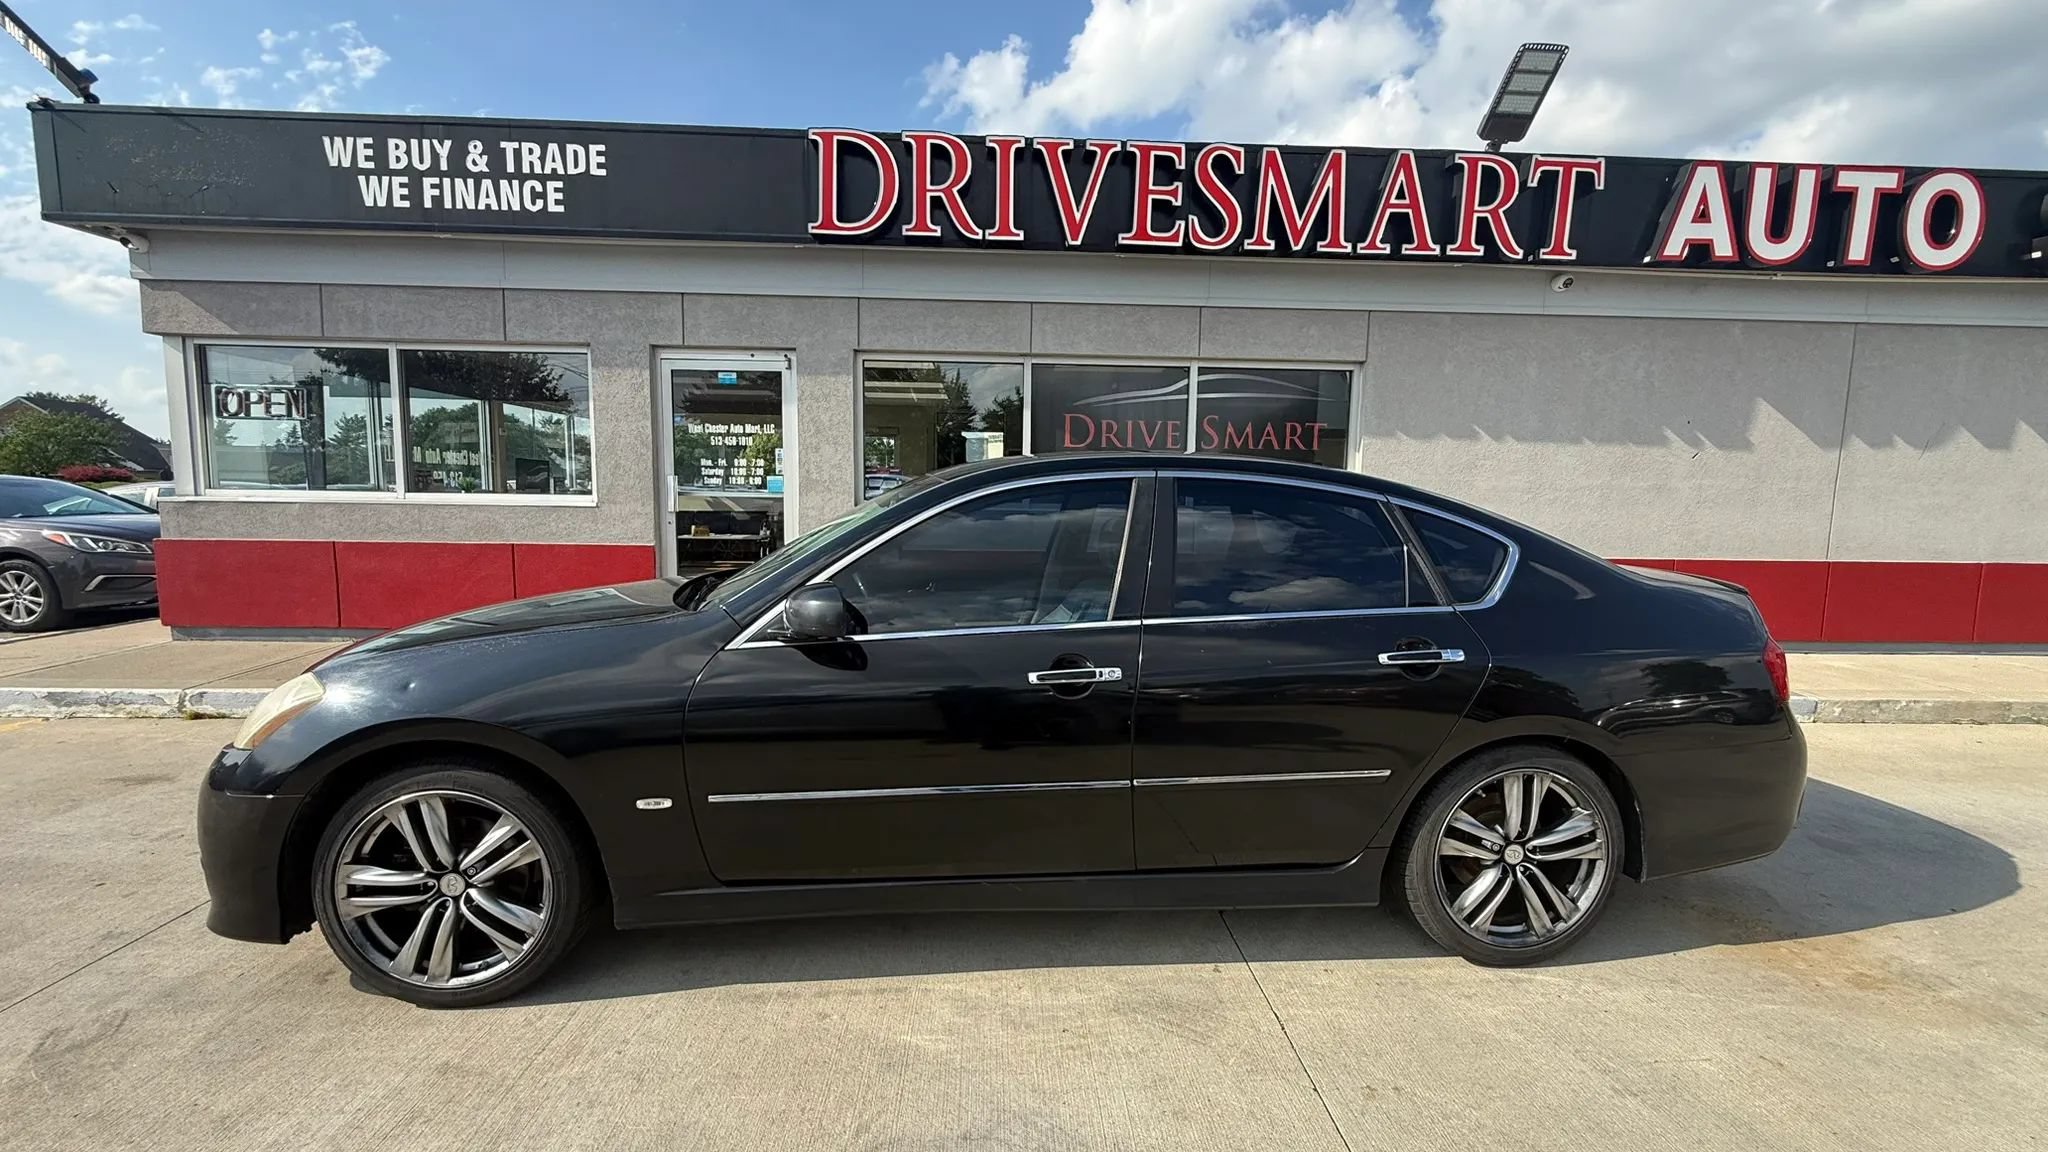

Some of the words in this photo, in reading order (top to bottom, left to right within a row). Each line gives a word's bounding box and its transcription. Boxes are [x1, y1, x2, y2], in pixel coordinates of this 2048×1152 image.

[321, 135, 375, 169] WE
[387, 137, 452, 171] BUY
[465, 139, 490, 173] &
[499, 140, 607, 176] TRADE
[357, 175, 411, 208] WE
[422, 177, 566, 213] FINANCE
[808, 128, 1605, 260] DRIVESMART
[1658, 160, 1987, 271] AUTO
[218, 388, 304, 418] OPEN
[688, 423, 704, 433] West
[704, 423, 728, 433] Chester
[729, 423, 744, 433] Auto
[763, 423, 775, 434] LLC
[1063, 412, 1181, 450] DRIVE
[1202, 415, 1329, 451] SMART
[701, 467, 725, 476] Saturday
[703, 476, 723, 485] Sunday
